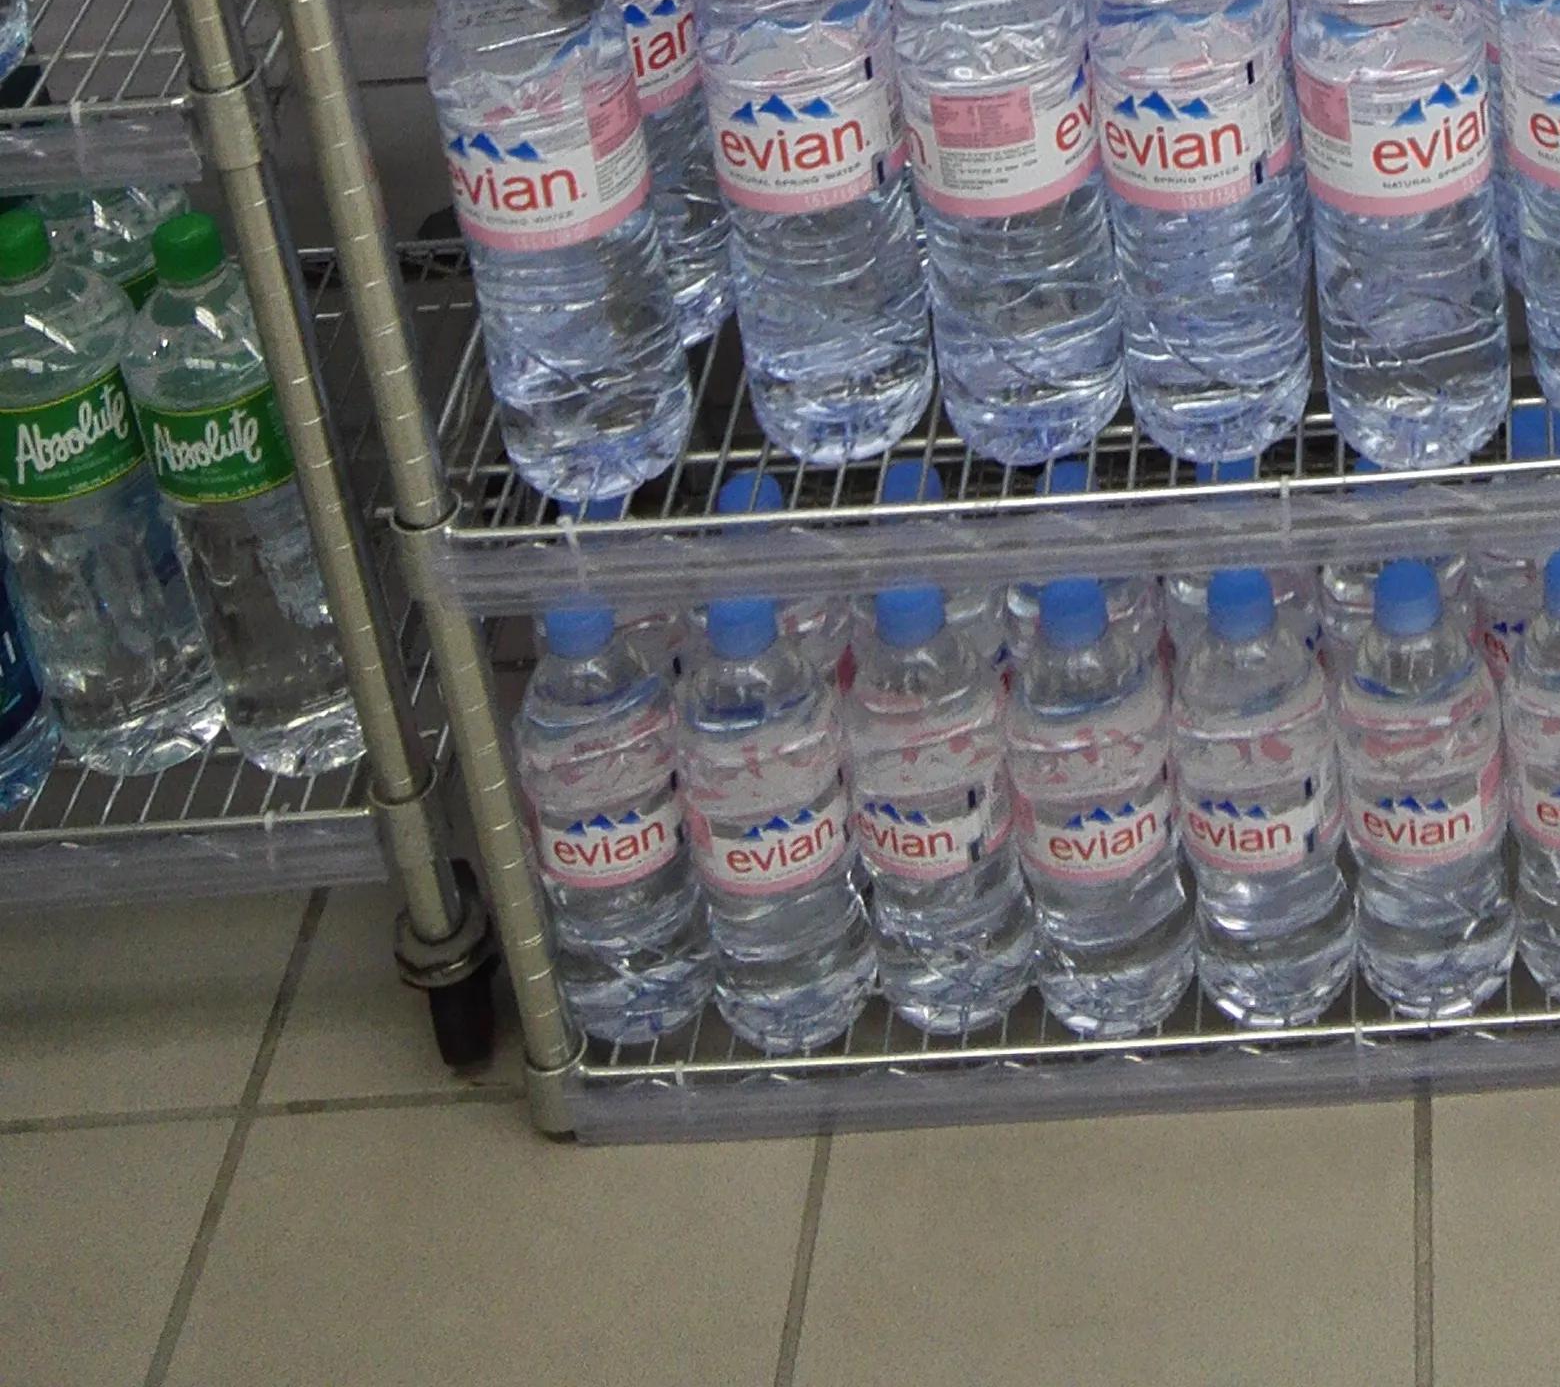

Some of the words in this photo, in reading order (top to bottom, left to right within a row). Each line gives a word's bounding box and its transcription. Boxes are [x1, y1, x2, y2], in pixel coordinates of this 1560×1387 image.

[632, 11, 694, 77] ian
[721, 120, 864, 172] evian
[1105, 121, 1243, 169] evian
[16, 384, 129, 484] Absolute
[153, 409, 262, 475] Absolute
[553, 819, 665, 866] evian
[726, 816, 834, 874] evian
[1049, 813, 1156, 860] evian
[1188, 813, 1292, 855] evian
[1363, 810, 1471, 851] evian
